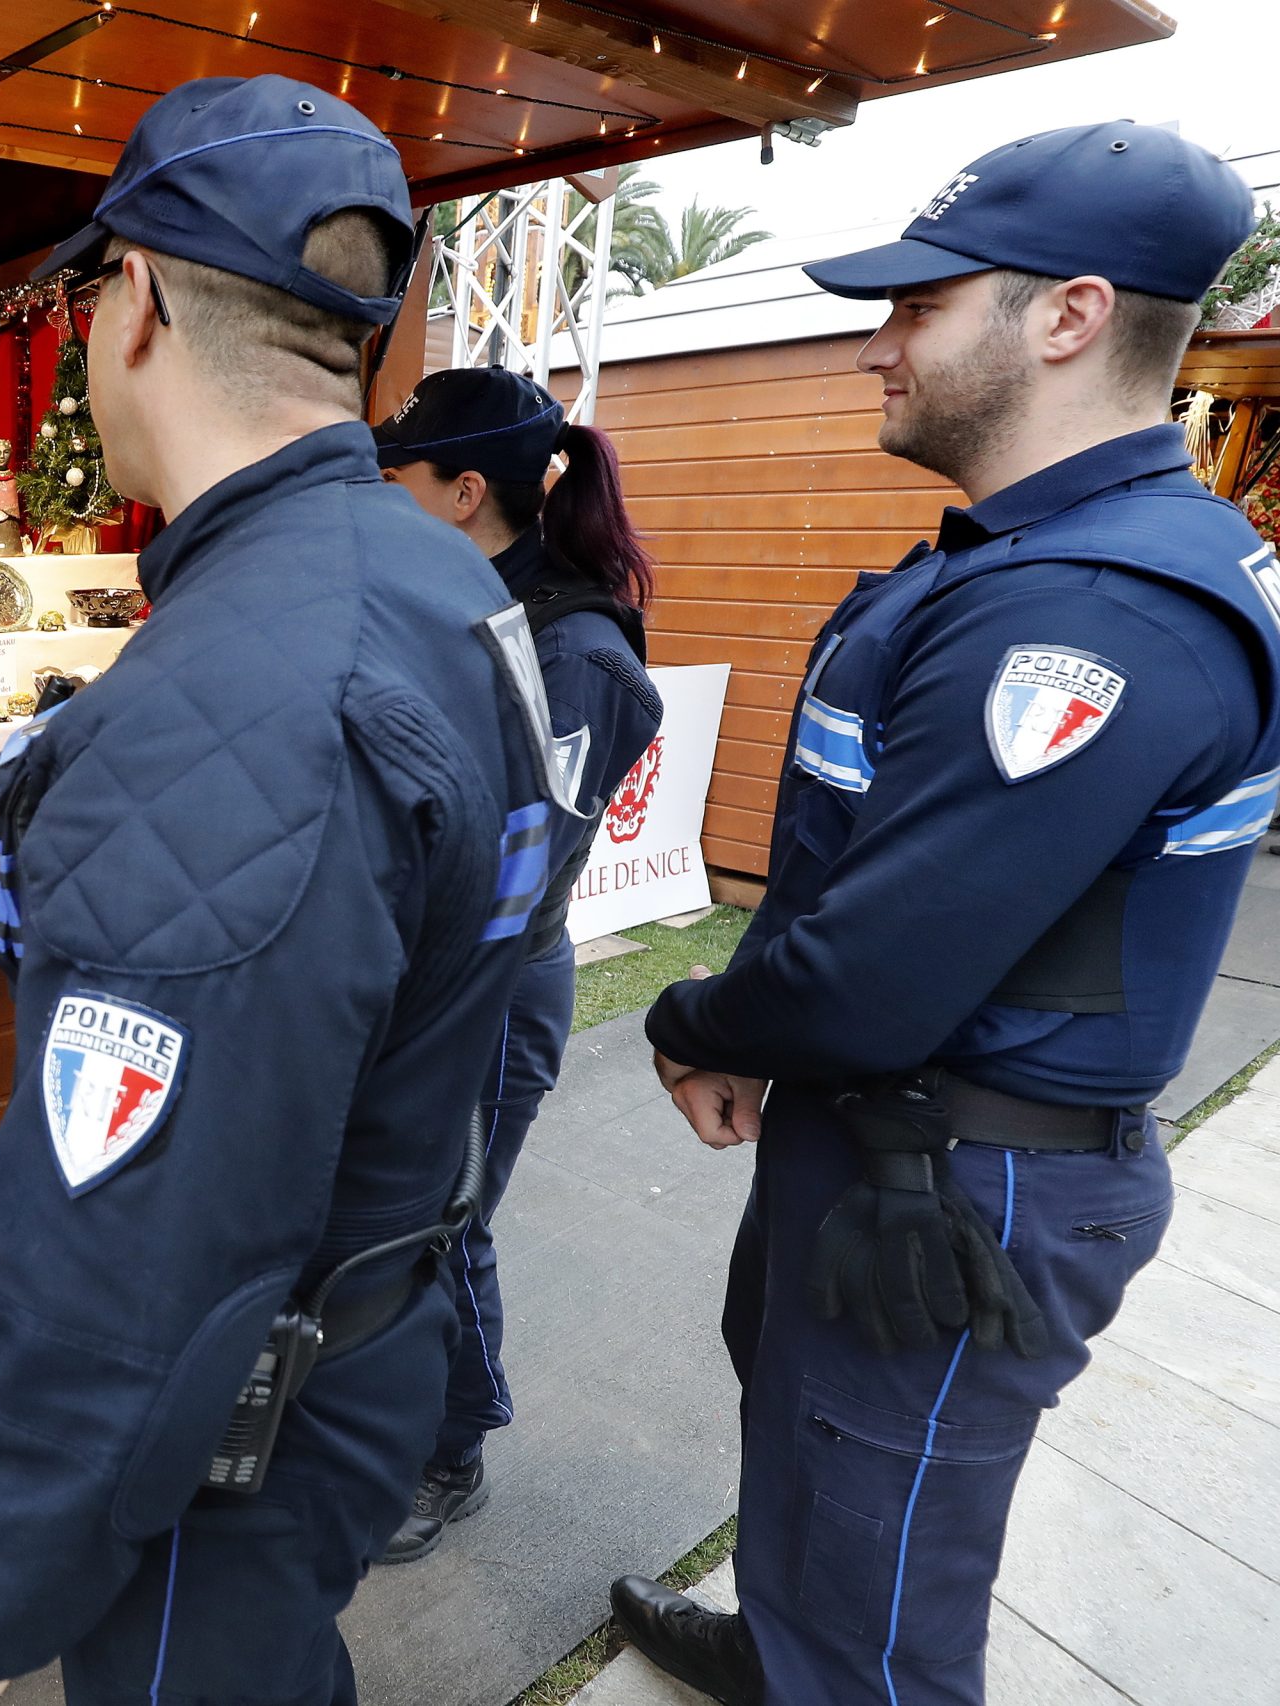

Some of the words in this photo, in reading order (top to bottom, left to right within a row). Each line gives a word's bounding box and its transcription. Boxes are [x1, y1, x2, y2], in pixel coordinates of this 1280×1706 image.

[1005, 672, 1112, 709] MUNICIPALE
[1011, 655, 1121, 697] POLICE
[615, 858, 640, 890] DE
[646, 846, 691, 882] NICE
[53, 1028, 170, 1080] MUNICIPALE
[59, 1003, 177, 1061] POLICE
